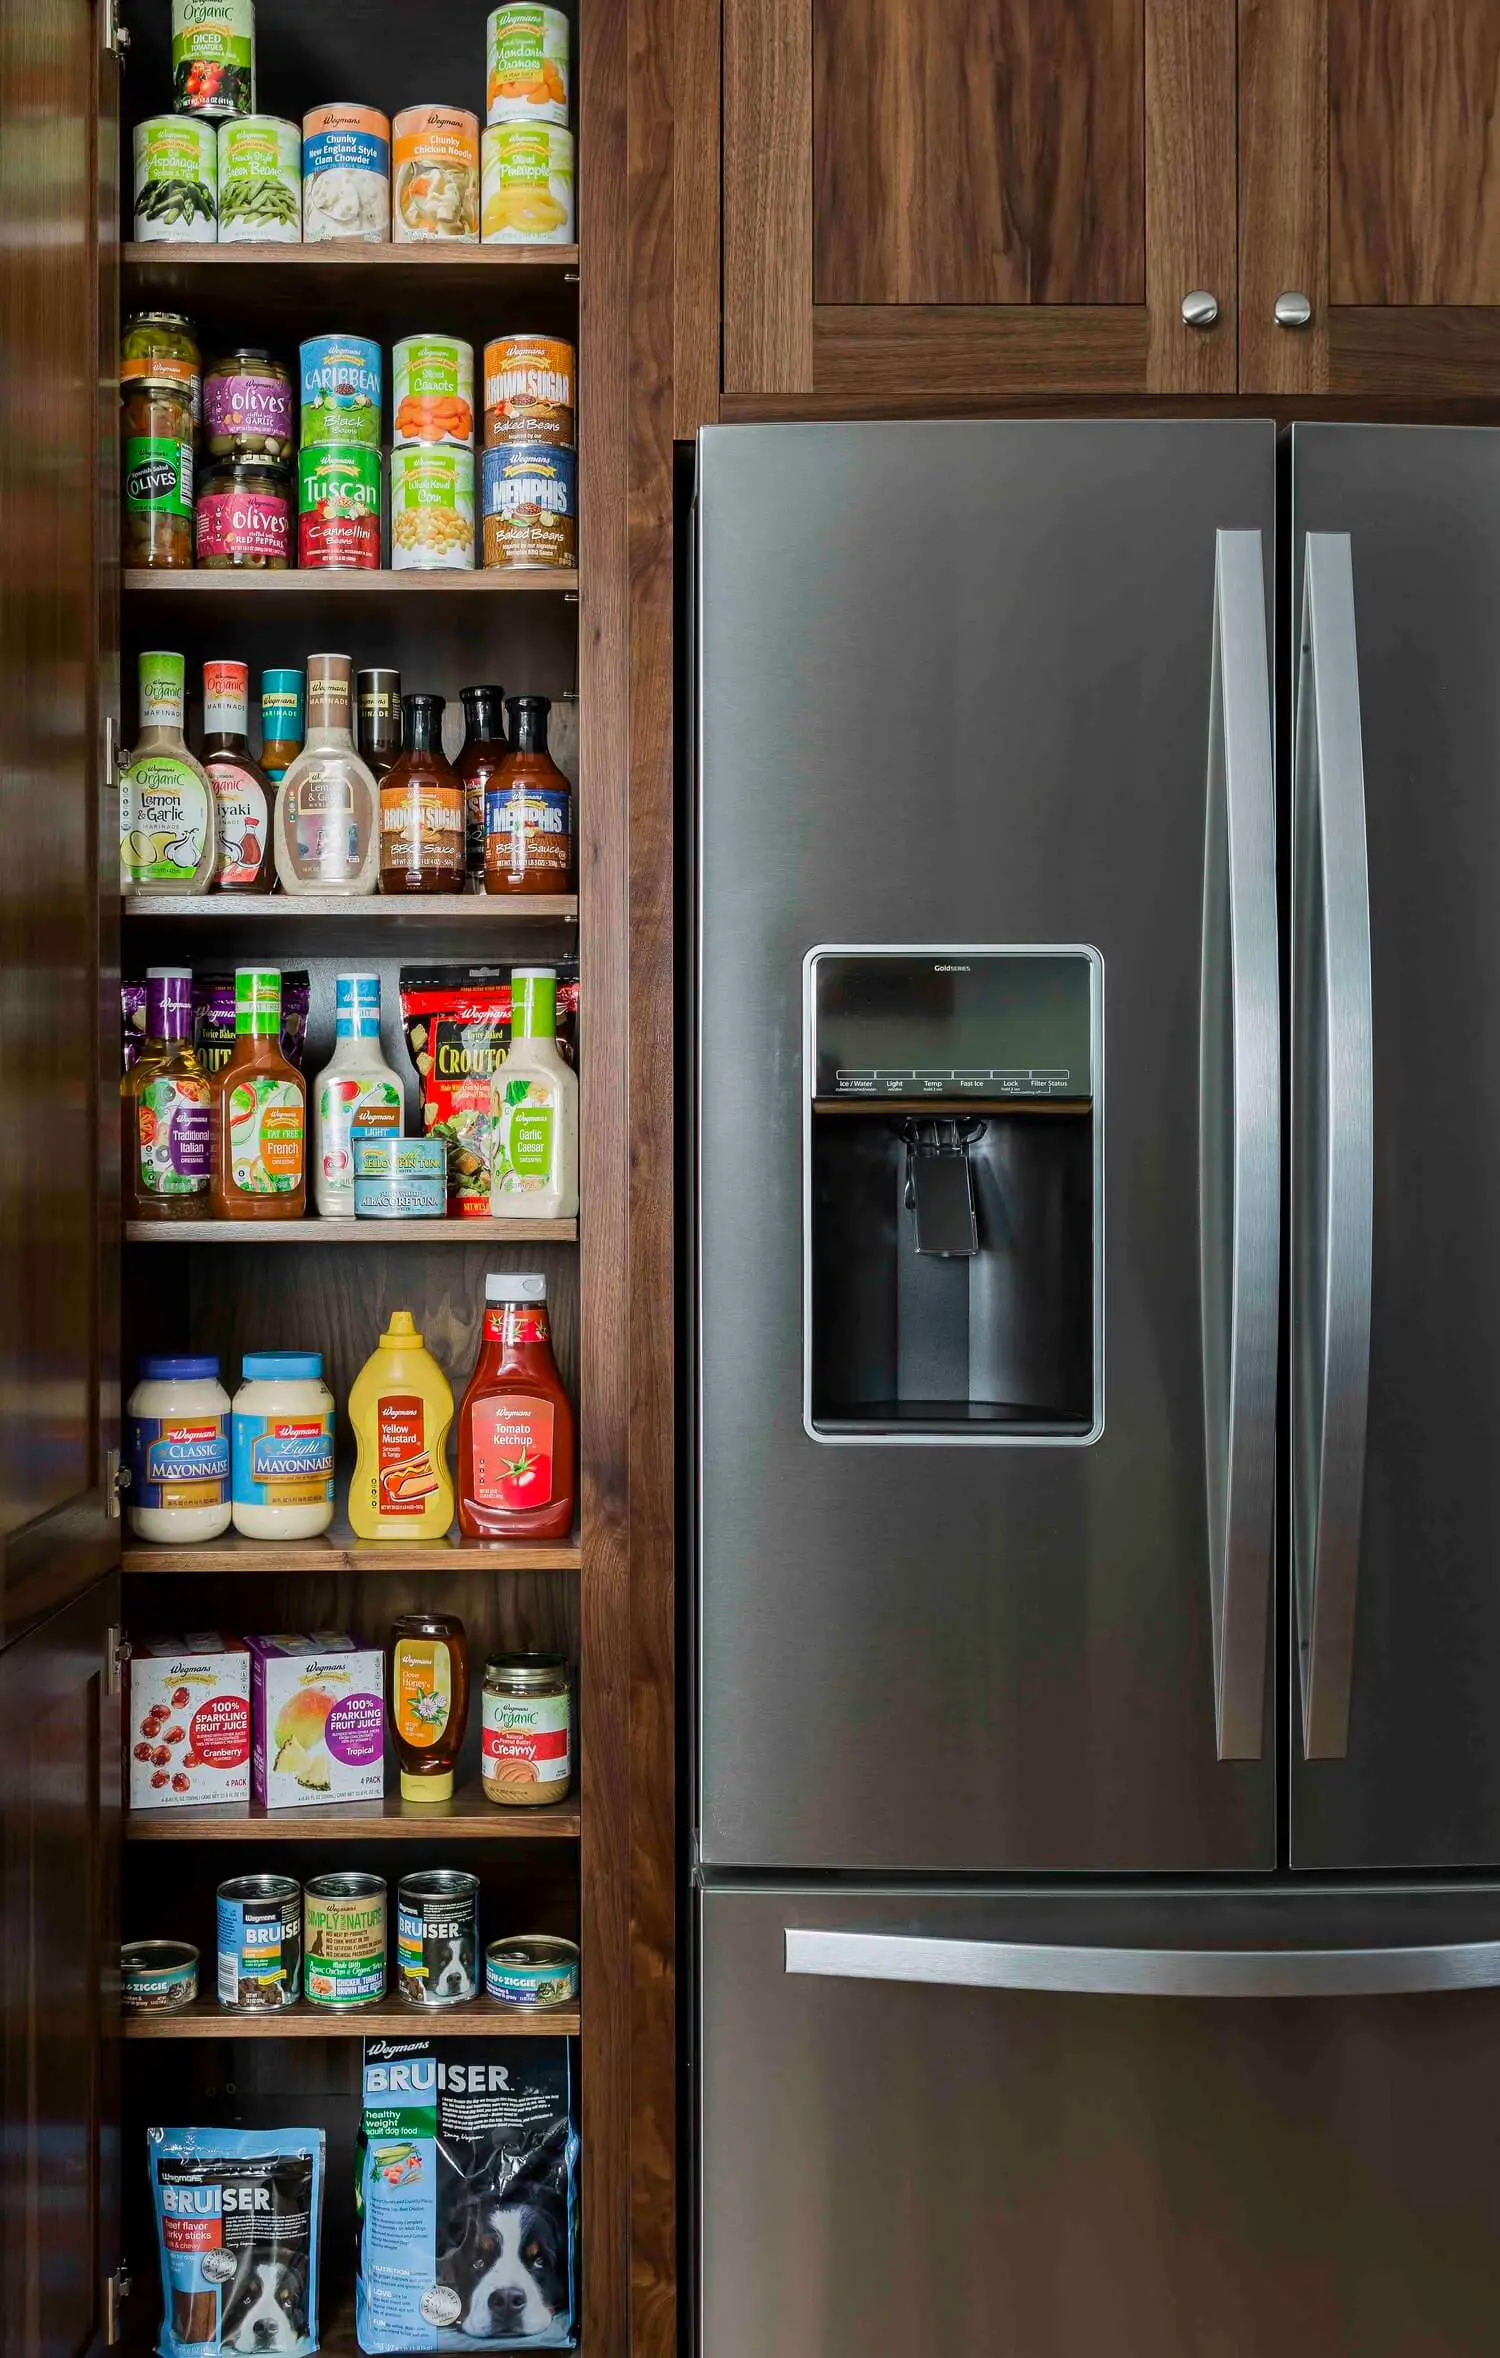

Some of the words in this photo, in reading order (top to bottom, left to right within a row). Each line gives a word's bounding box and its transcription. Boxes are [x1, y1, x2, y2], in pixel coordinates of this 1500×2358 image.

[183, 4, 234, 23] Organic
[499, 13, 542, 27] Wegmans
[193, 34, 221, 44] DICED
[496, 45, 543, 60] Mandarin
[498, 60, 540, 73] Oranges
[323, 113, 361, 127] Wegmans
[427, 112, 464, 129] Wegmans
[326, 134, 357, 145] Chunky
[430, 135, 461, 148] Chunky
[309, 148, 323, 158] New
[323, 144, 356, 154] England
[358, 145, 378, 157] Style
[414, 145, 446, 154] Chicken
[448, 147, 473, 160] Noodle
[315, 155, 333, 165] Clam
[334, 153, 370, 165] Chowder
[501, 165, 550, 179] Pineapple
[328, 345, 361, 356] Wegmans
[506, 346, 547, 357] Wegmans
[304, 368, 381, 391] CARIBBEAN
[414, 379, 454, 392] Carrots
[528, 371, 569, 403] SUGAR
[231, 389, 285, 414] olives
[245, 417, 274, 426] GARLIC
[323, 415, 365, 428] Black
[494, 419, 526, 434] Baked
[526, 418, 560, 431] Beans
[320, 455, 356, 465] Wegmans
[510, 452, 550, 464] Wegmans
[130, 473, 177, 495] OLIVES
[303, 476, 376, 505] Tuscan
[492, 479, 567, 513] MEMPHIS
[232, 506, 285, 530] olives
[308, 525, 371, 540] Cannellini
[496, 528, 530, 542] Baked
[531, 527, 564, 541] Beans
[235, 535, 254, 544] RED
[254, 536, 284, 549] PEPPERS
[326, 536, 353, 545] Beans
[144, 684, 182, 700] Organic
[207, 679, 245, 694] Organic
[312, 682, 348, 695] Wegmans
[207, 704, 246, 712] MARINADE
[263, 695, 296, 708] Wegmans
[309, 697, 348, 706] MARINADE
[262, 709, 297, 718] MARINADE
[136, 771, 185, 788] Organic
[141, 793, 181, 807] Lemon
[146, 807, 184, 821] Garlic
[426, 807, 461, 830] SUGAR
[492, 807, 562, 834] MEMPHIS
[423, 843, 455, 855] Sauce
[527, 843, 560, 854] Sauce
[455, 1008, 512, 1024] Wegmans
[202, 1030, 219, 1038] Twice
[886, 1080, 903, 1088] Light
[176, 1113, 208, 1127] Wegmans
[358, 1111, 395, 1124] Wegmans
[515, 1114, 548, 1124] Wegmans
[172, 1130, 210, 1141] Traditional
[267, 1129, 281, 1138] FAT
[283, 1129, 299, 1138] FREE
[364, 1127, 390, 1137] LIGHT
[519, 1129, 543, 1140] Garlic
[180, 1142, 204, 1153] Italian
[267, 1142, 299, 1154] French
[517, 1142, 544, 1153] Caesar
[361, 1196, 410, 1206] ALBACORE
[412, 1196, 439, 1206] TUNA
[382, 1407, 417, 1422] Wegmans
[496, 1408, 532, 1421] Wegmans
[168, 1426, 216, 1443] Wegmans
[279, 1425, 321, 1437] Wegmans
[382, 1424, 409, 1434] Yellow
[496, 1424, 531, 1434] Tomato
[382, 1434, 417, 1444] Mustard
[493, 1434, 533, 1445] Ketchup
[169, 1444, 217, 1458] CLASSIC
[281, 1440, 320, 1457] Light
[151, 1459, 228, 1477] MAYONNAISE
[256, 1456, 333, 1473] MAYONNAISE
[402, 1654, 432, 1666] Wegmans
[170, 1662, 212, 1676] Wegmans
[305, 1661, 346, 1675] Wegmans
[402, 1679, 427, 1689] Honey
[211, 1702, 240, 1713] 100%
[345, 1699, 374, 1711] 100%
[195, 1711, 248, 1724] SPARKLING
[330, 1710, 381, 1722] SPARKLING
[494, 1707, 539, 1727] Organic
[195, 1721, 220, 1732] FRUIT
[222, 1719, 248, 1730] JUICE
[330, 1719, 355, 1730] FRUIT
[357, 1717, 381, 1728] JUICE
[203, 1748, 242, 1758] Cranberry
[345, 1745, 374, 1757] Tropical
[491, 1739, 537, 1759] Creamy
[225, 1779, 230, 1787] 4
[230, 1778, 247, 1787] PACK
[360, 1777, 365, 1785] 4
[365, 1776, 381, 1784] PACK
[245, 1914, 276, 1923] Wegmans
[308, 1911, 340, 1930] SIMPLY
[346, 1907, 382, 1930] NATURE
[399, 1917, 460, 1939] BRUISER
[133, 1982, 168, 1992] ZIGGIE
[503, 1975, 537, 1987] ZIGGIE
[366, 2040, 430, 2060] Wegmans
[366, 2063, 511, 2094] BRUISER
[366, 2110, 401, 2120] healthy
[366, 2119, 398, 2129] weight
[385, 2127, 400, 2137] dog
[401, 2127, 418, 2135] food
[162, 2172, 203, 2183] Wegmans
[162, 2187, 270, 2214] BRUISER
[183, 2221, 208, 2231] flavor
[184, 2230, 212, 2240] sticks
[179, 2242, 201, 2250] chewy
[373, 2265, 409, 2276] NUTRITION
